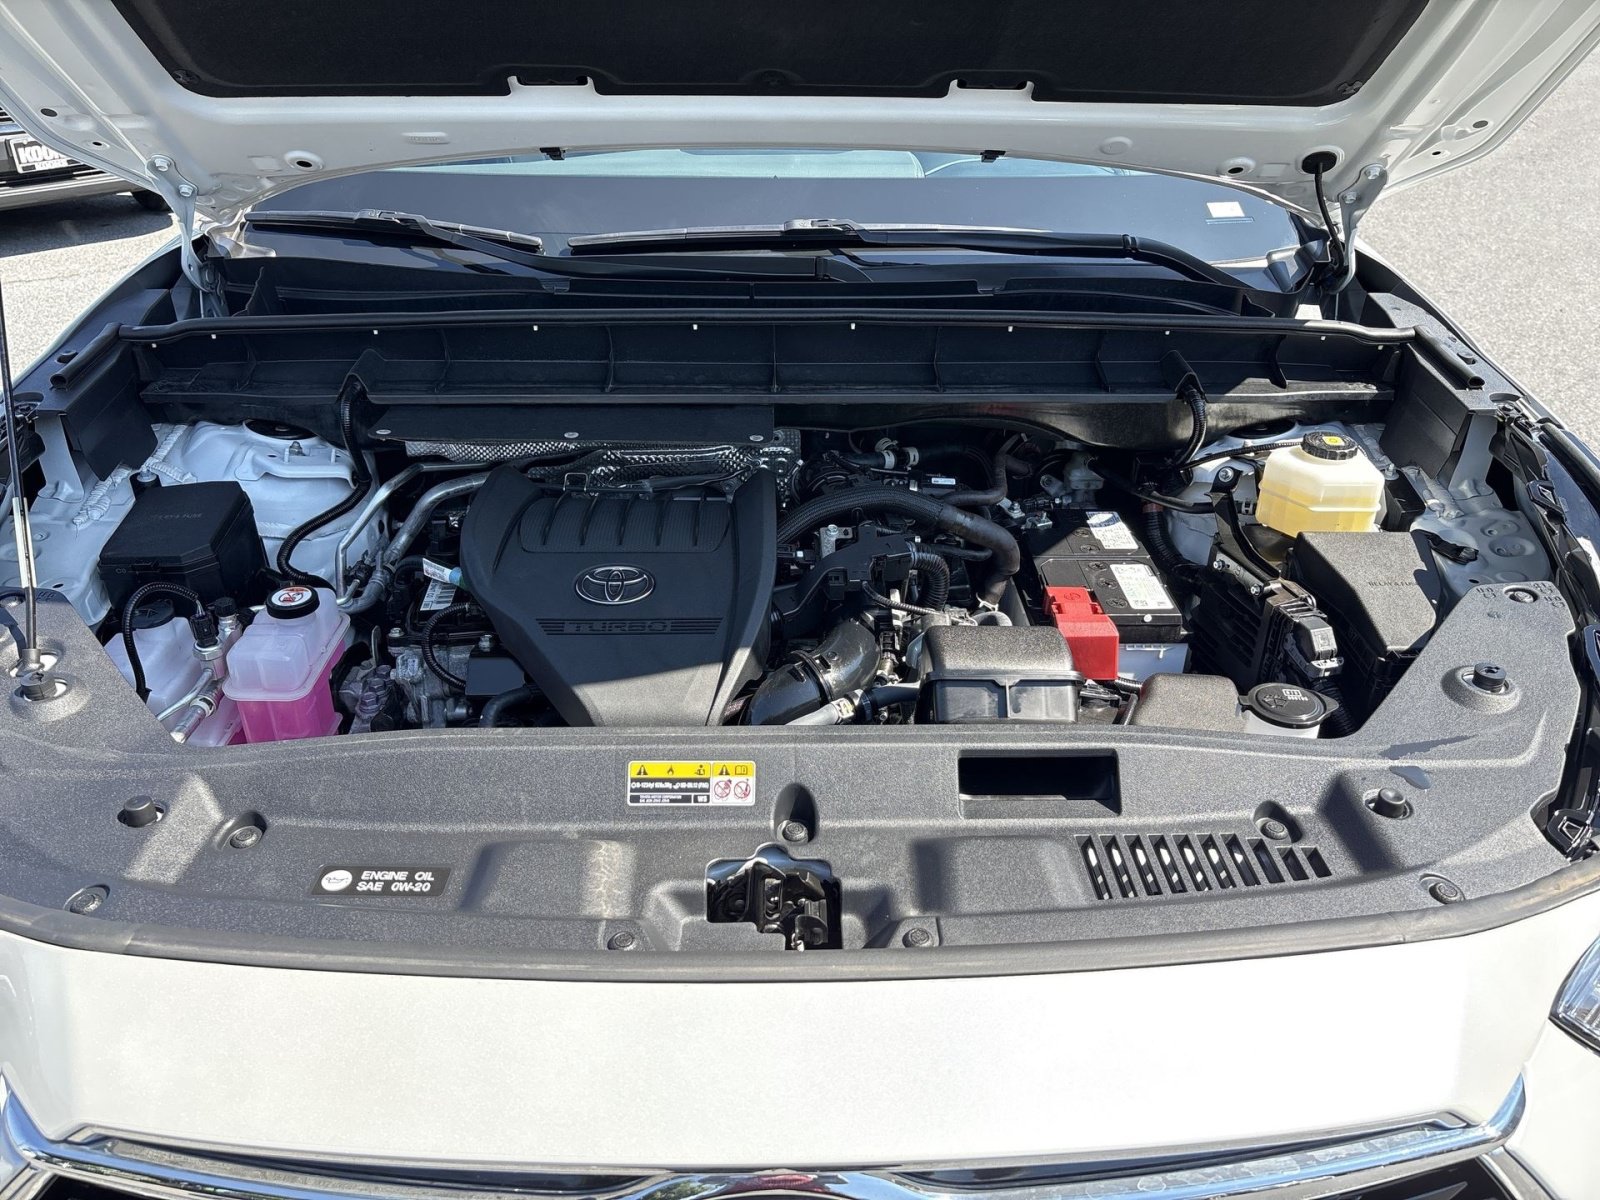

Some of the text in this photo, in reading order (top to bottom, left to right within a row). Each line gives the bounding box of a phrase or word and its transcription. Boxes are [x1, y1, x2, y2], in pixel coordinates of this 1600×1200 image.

[568, 621, 667, 632] TURBO
[361, 870, 435, 881] ENGINE OIL
[356, 881, 384, 891] SAE
